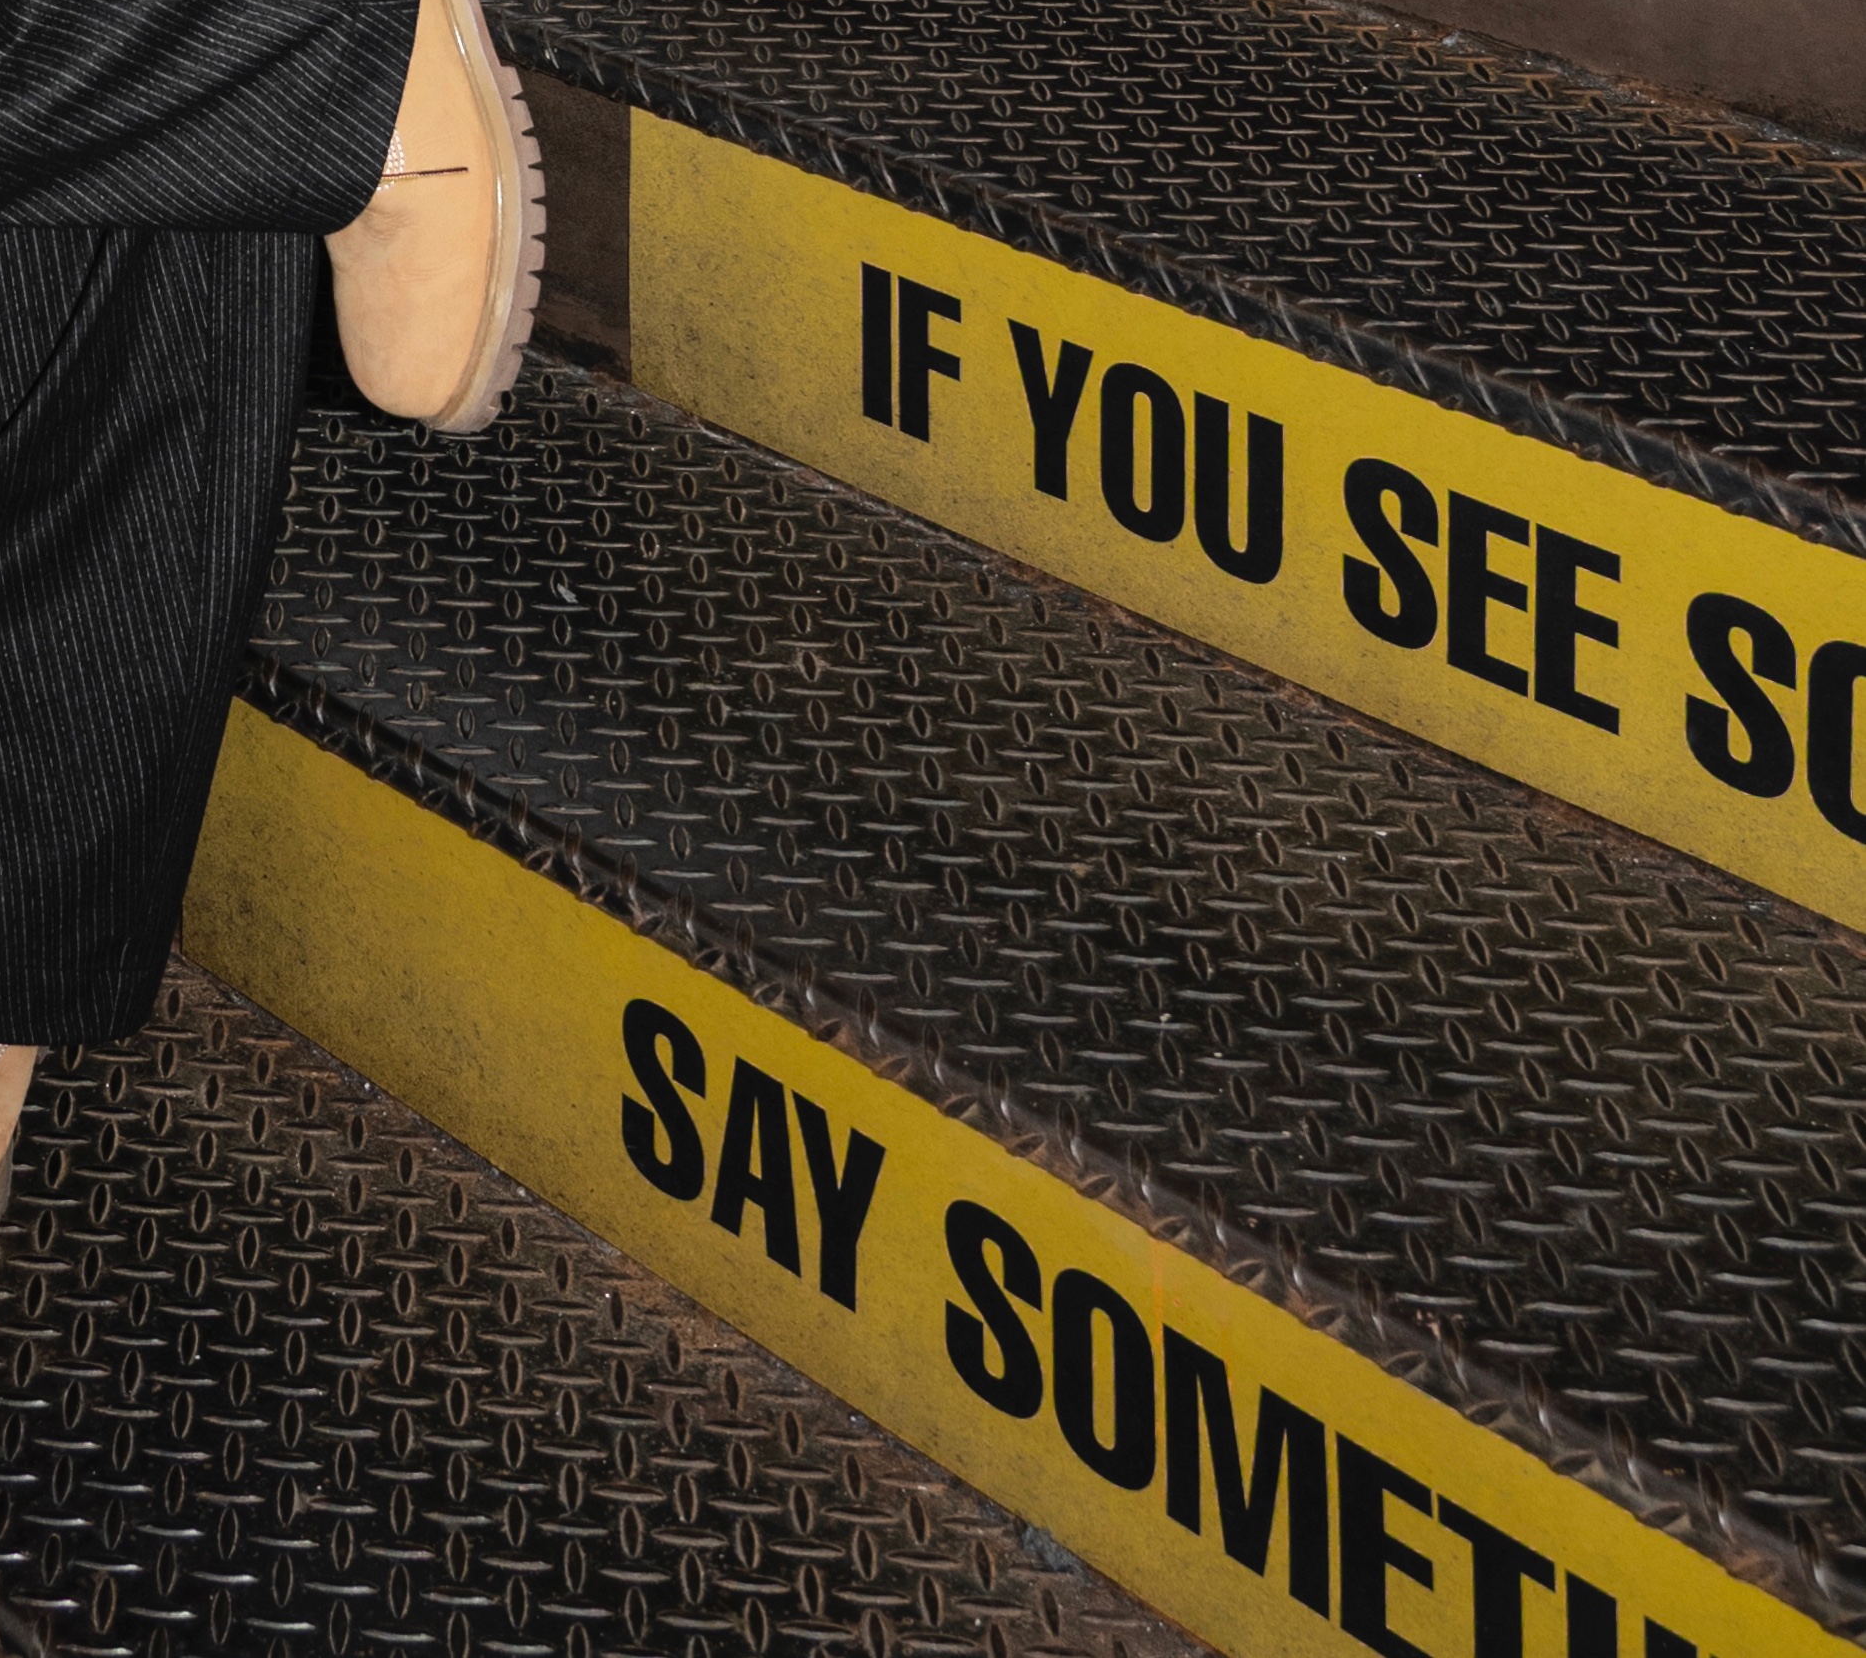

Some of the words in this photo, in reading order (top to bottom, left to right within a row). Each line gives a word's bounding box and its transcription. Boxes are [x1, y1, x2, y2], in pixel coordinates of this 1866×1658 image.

[861, 261, 962, 443] IF
[1007, 317, 1284, 585] YOU
[1342, 457, 1621, 736] SEE
[620, 997, 886, 1314] SAY
